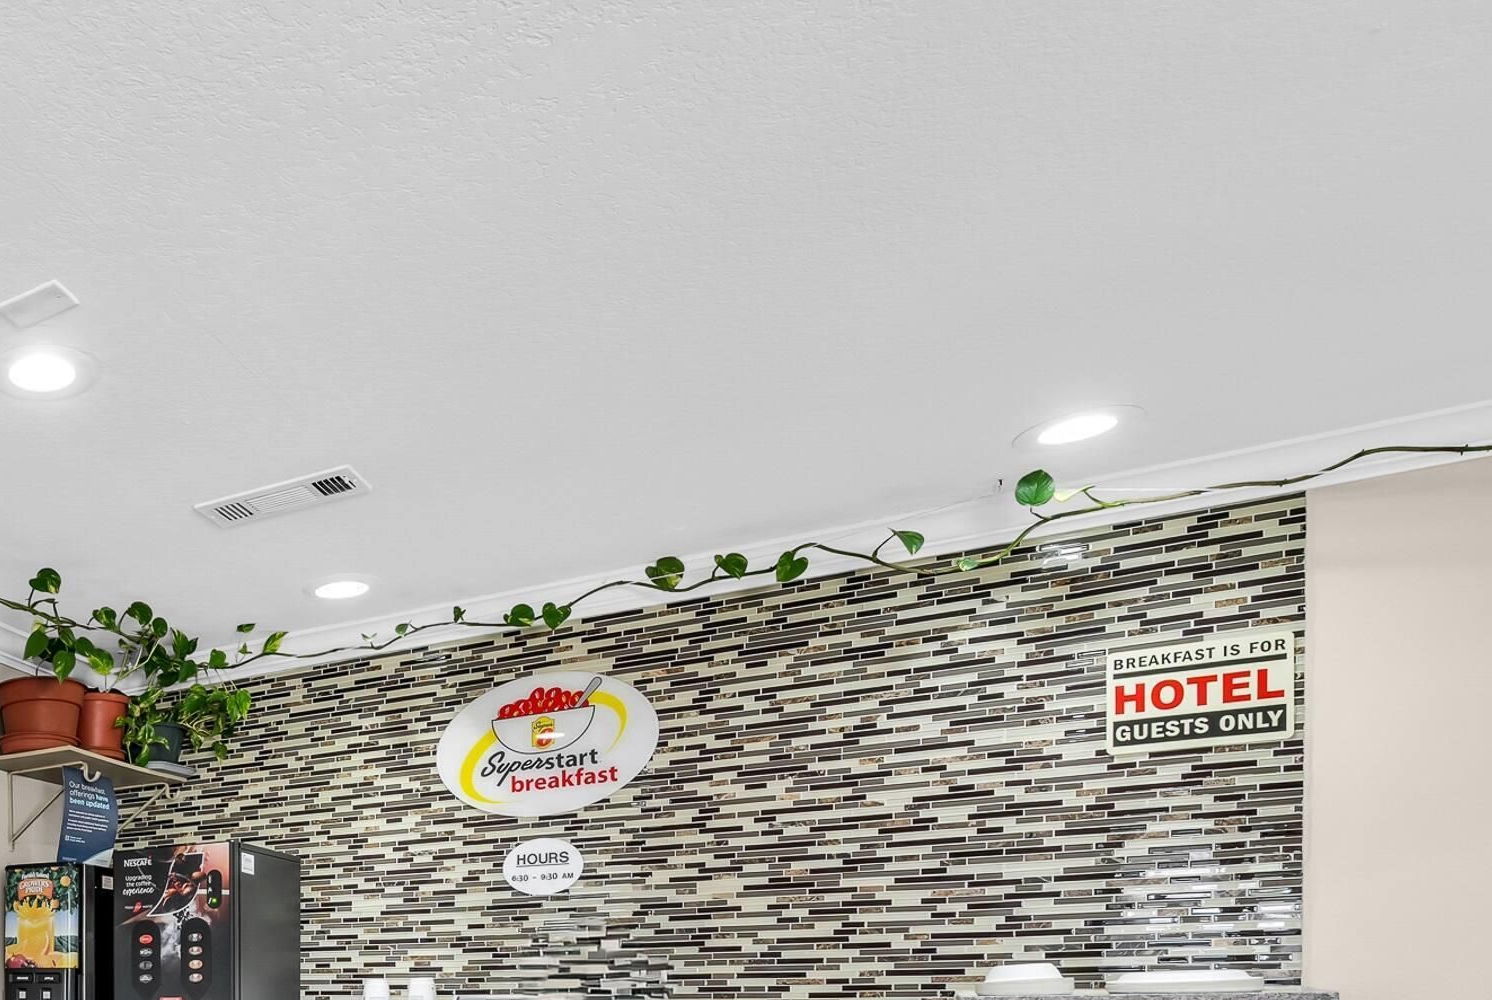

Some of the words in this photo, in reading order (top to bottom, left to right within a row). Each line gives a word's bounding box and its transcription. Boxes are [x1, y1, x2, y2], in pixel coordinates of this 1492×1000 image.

[1113, 647, 1216, 671] BREAKFAST
[1223, 643, 1240, 657] IS
[1249, 638, 1286, 654] FOR
[1114, 668, 1285, 715] HOTEL
[1115, 716, 1209, 742] GUESTS
[1219, 709, 1284, 732] ONLY
[480, 749, 598, 787] Superstart
[511, 766, 618, 793] breakfast
[516, 851, 570, 865] HOURS
[511, 874, 529, 882] 6:30
[540, 872, 558, 881] 9:30
